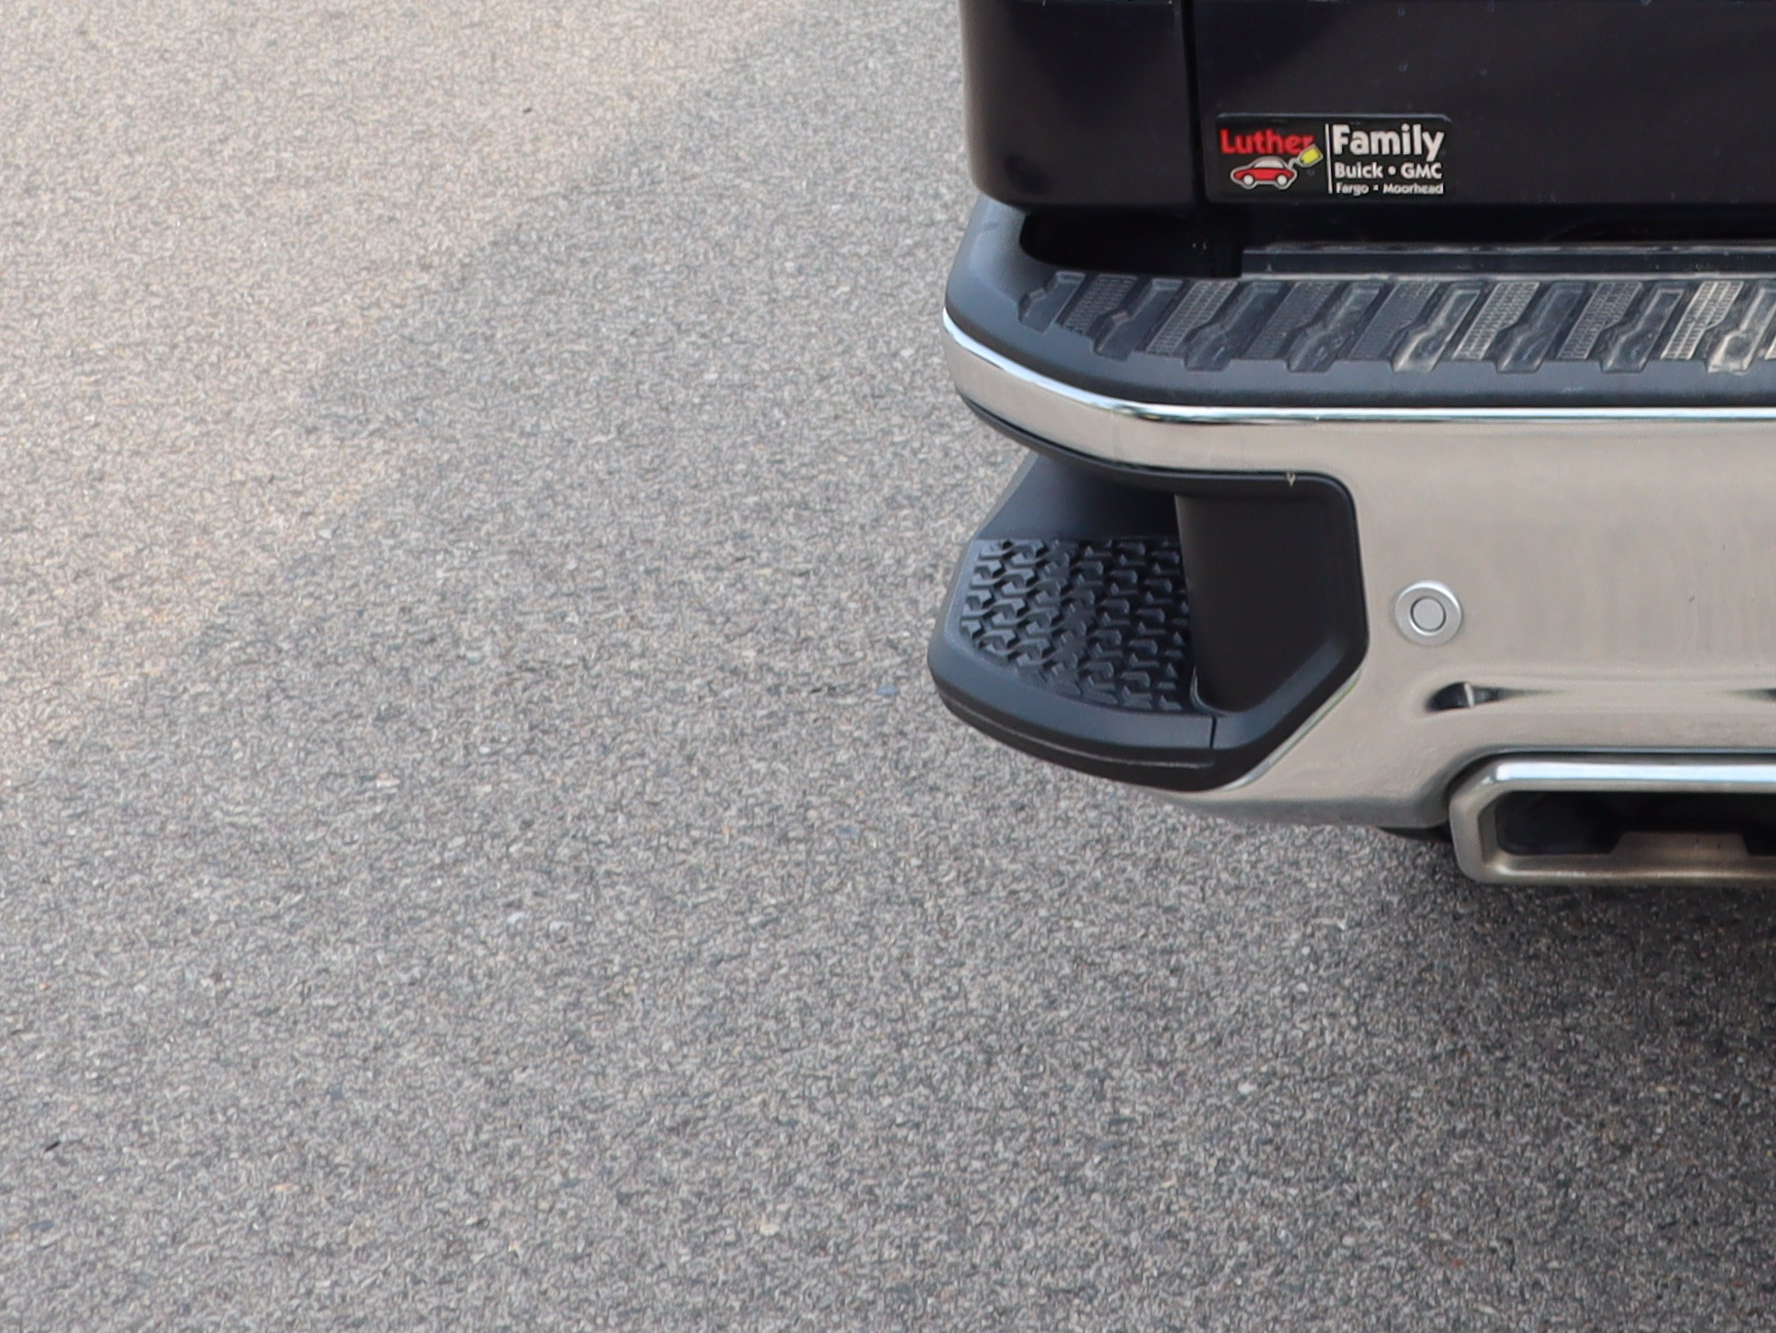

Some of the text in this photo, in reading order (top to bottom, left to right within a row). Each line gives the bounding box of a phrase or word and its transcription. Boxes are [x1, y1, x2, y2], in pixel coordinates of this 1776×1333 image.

[1219, 123, 1445, 162] Luther Family
[1334, 162, 1442, 179] Buick GMC
[1336, 182, 1444, 197] Fargo Moorhead
